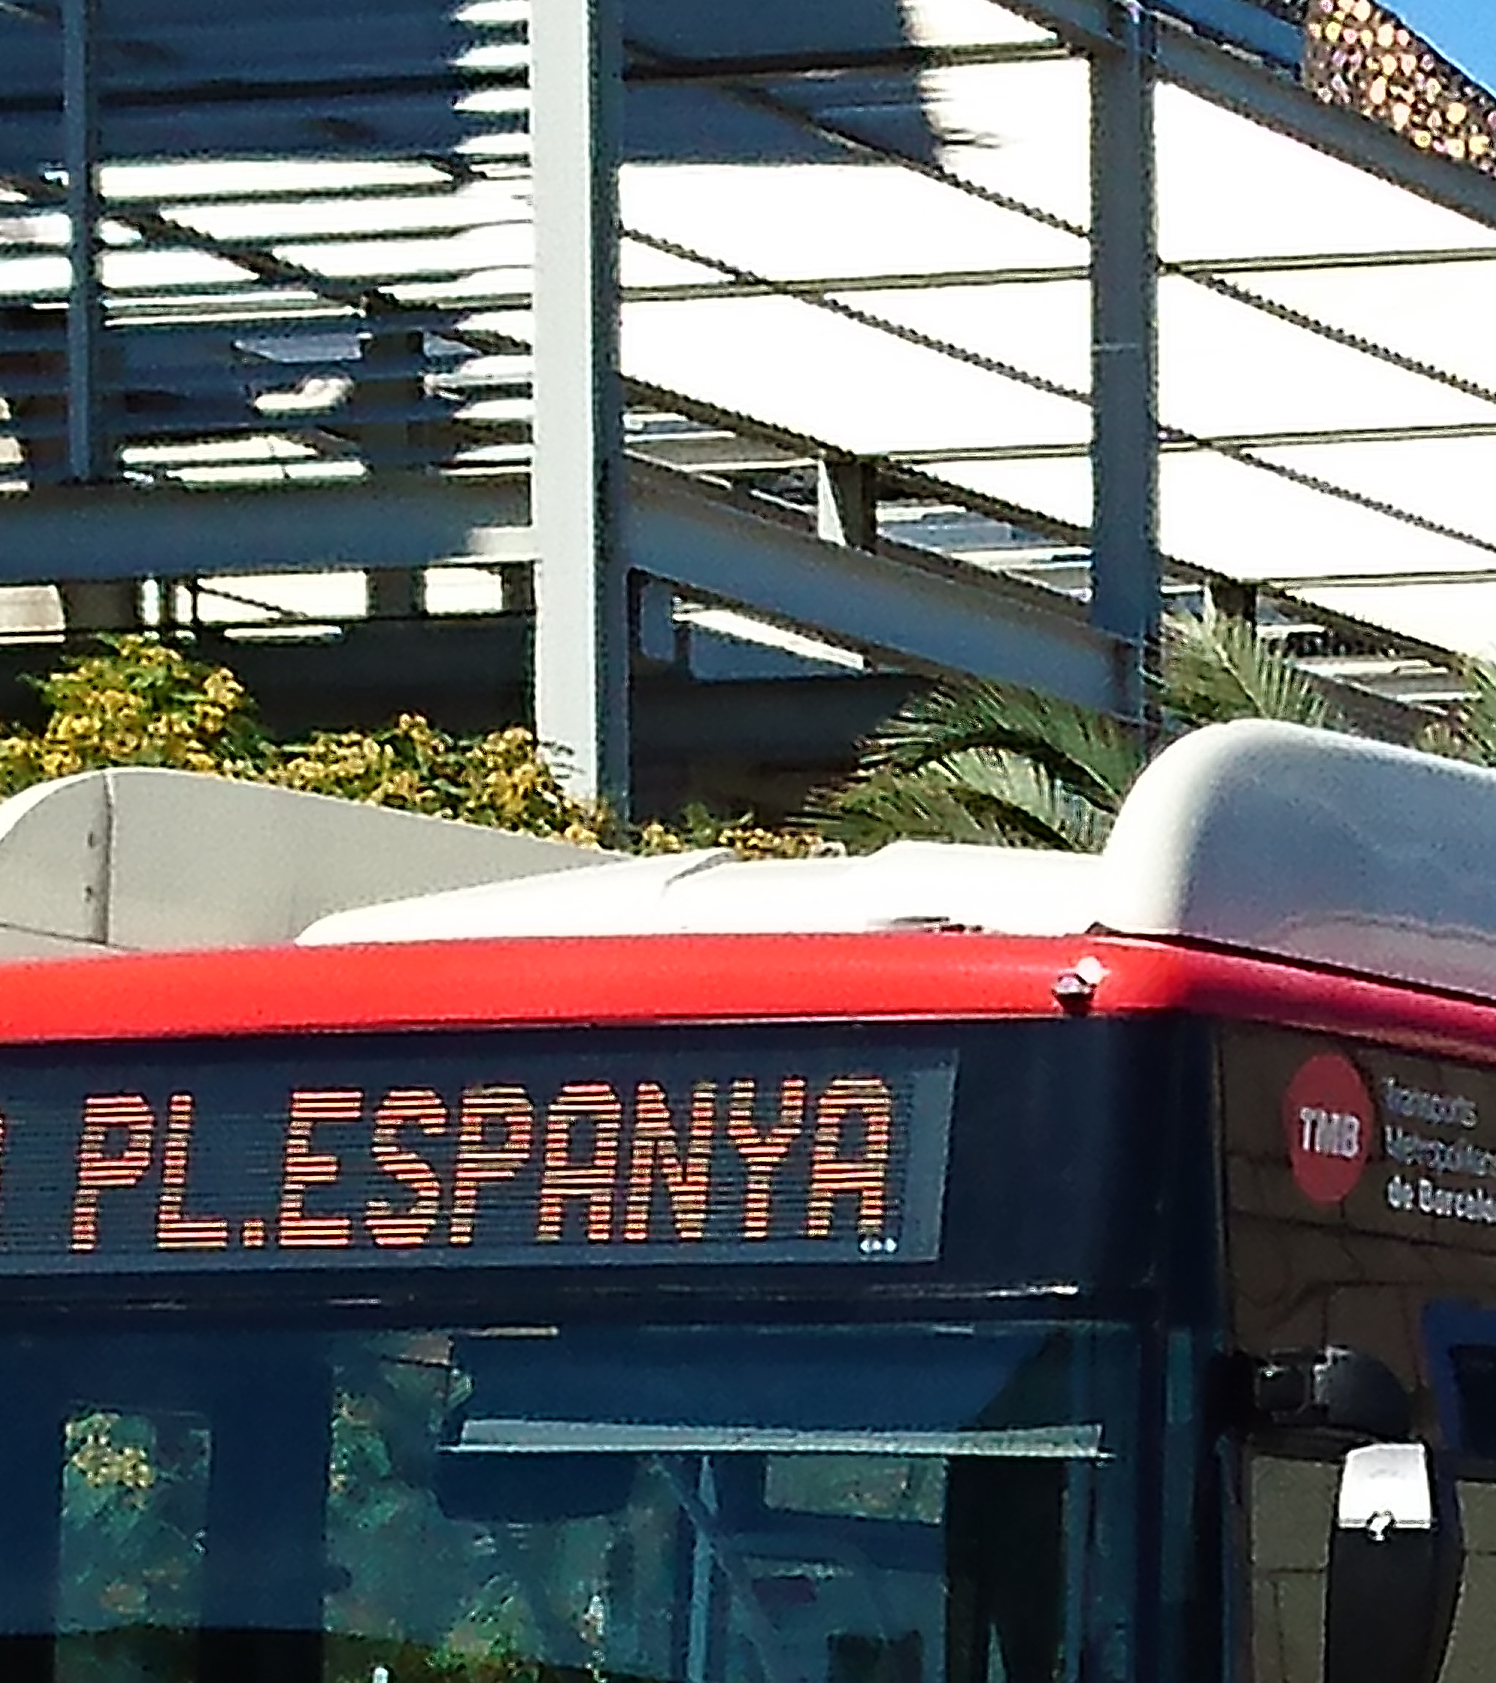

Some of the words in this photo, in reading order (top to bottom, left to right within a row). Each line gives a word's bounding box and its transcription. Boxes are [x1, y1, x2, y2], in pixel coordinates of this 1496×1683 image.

[1299, 1107, 1360, 1158] TMB
[71, 1077, 895, 1252] PL.ESPANYA
[1387, 1174, 1415, 1211] de
